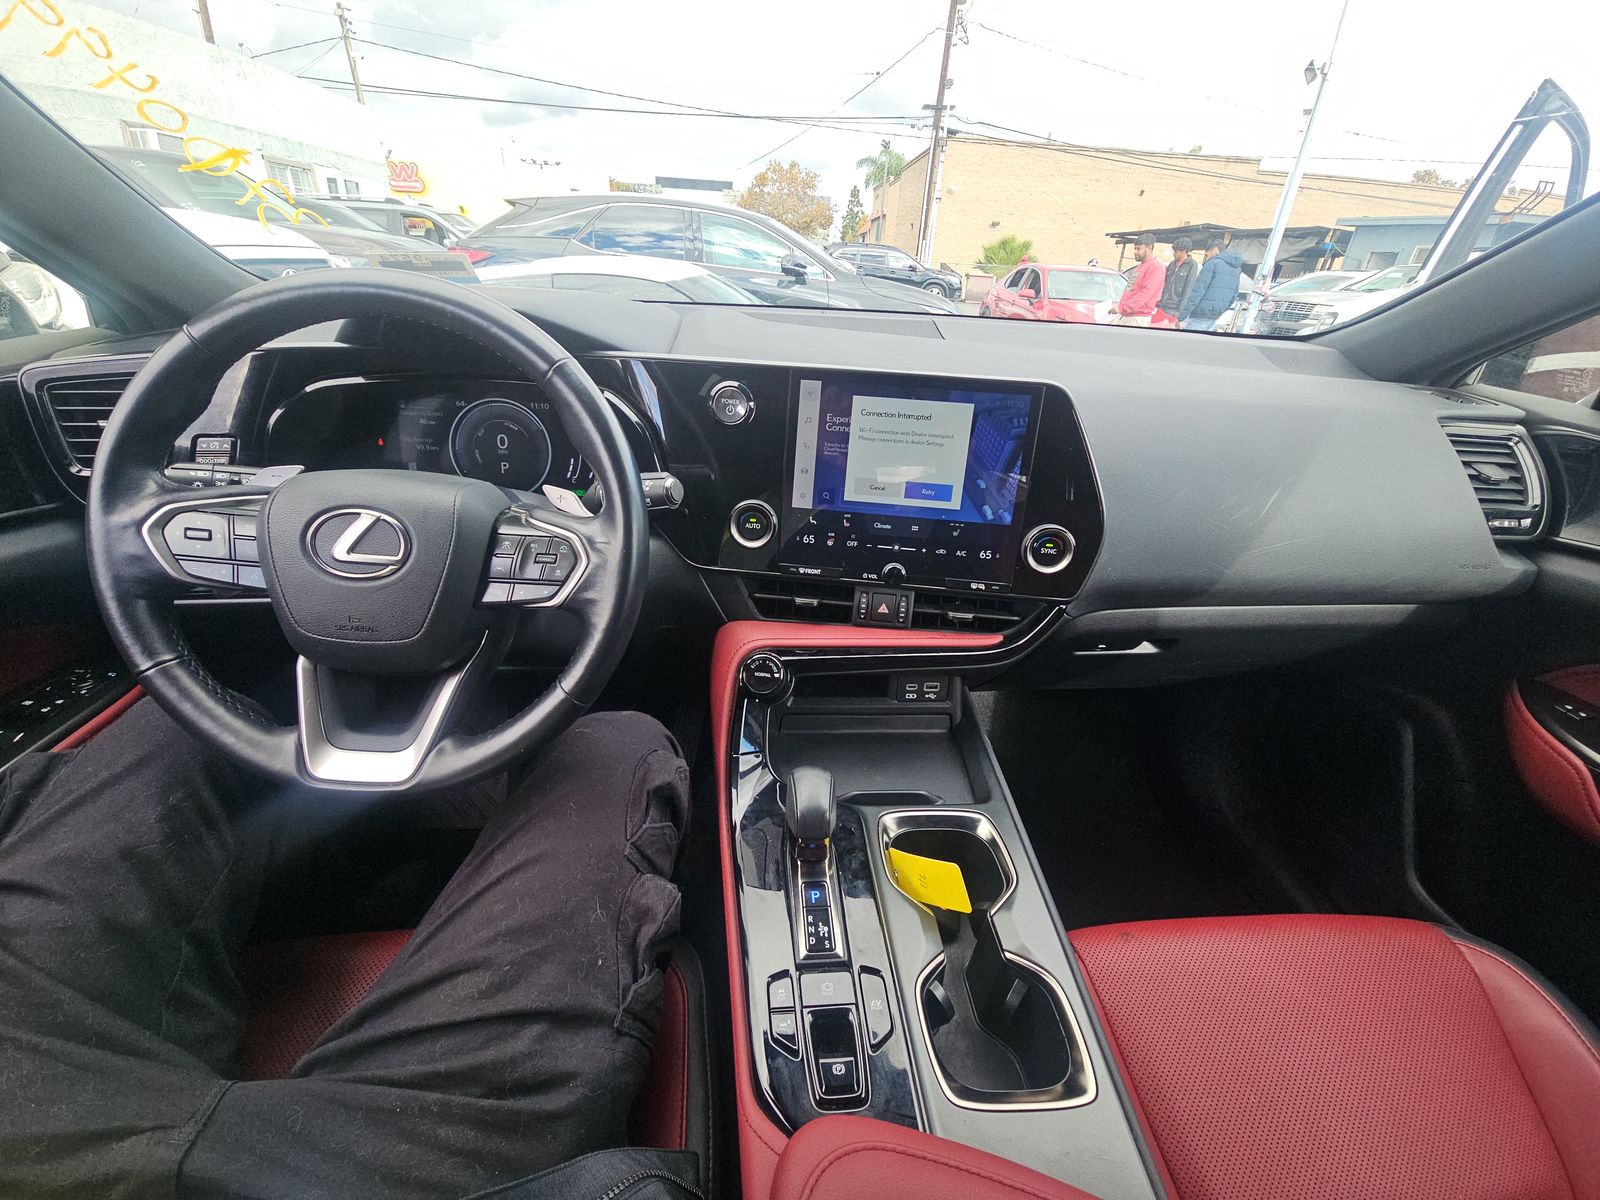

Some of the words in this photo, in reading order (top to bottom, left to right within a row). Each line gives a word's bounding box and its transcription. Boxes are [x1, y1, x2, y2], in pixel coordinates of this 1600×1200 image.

[530, 402, 550, 410] 11:10
[860, 408, 896, 418] Connection
[897, 412, 932, 422] Interrupted
[496, 434, 508, 449] 0
[501, 461, 510, 474] P
[869, 484, 886, 492] Cancel
[921, 488, 936, 497] Retry
[802, 534, 816, 544] 65
[979, 550, 992, 560] 65
[1040, 547, 1058, 555] SYNC
[810, 890, 820, 904] P
[808, 926, 814, 934] N
[824, 940, 830, 948] S
